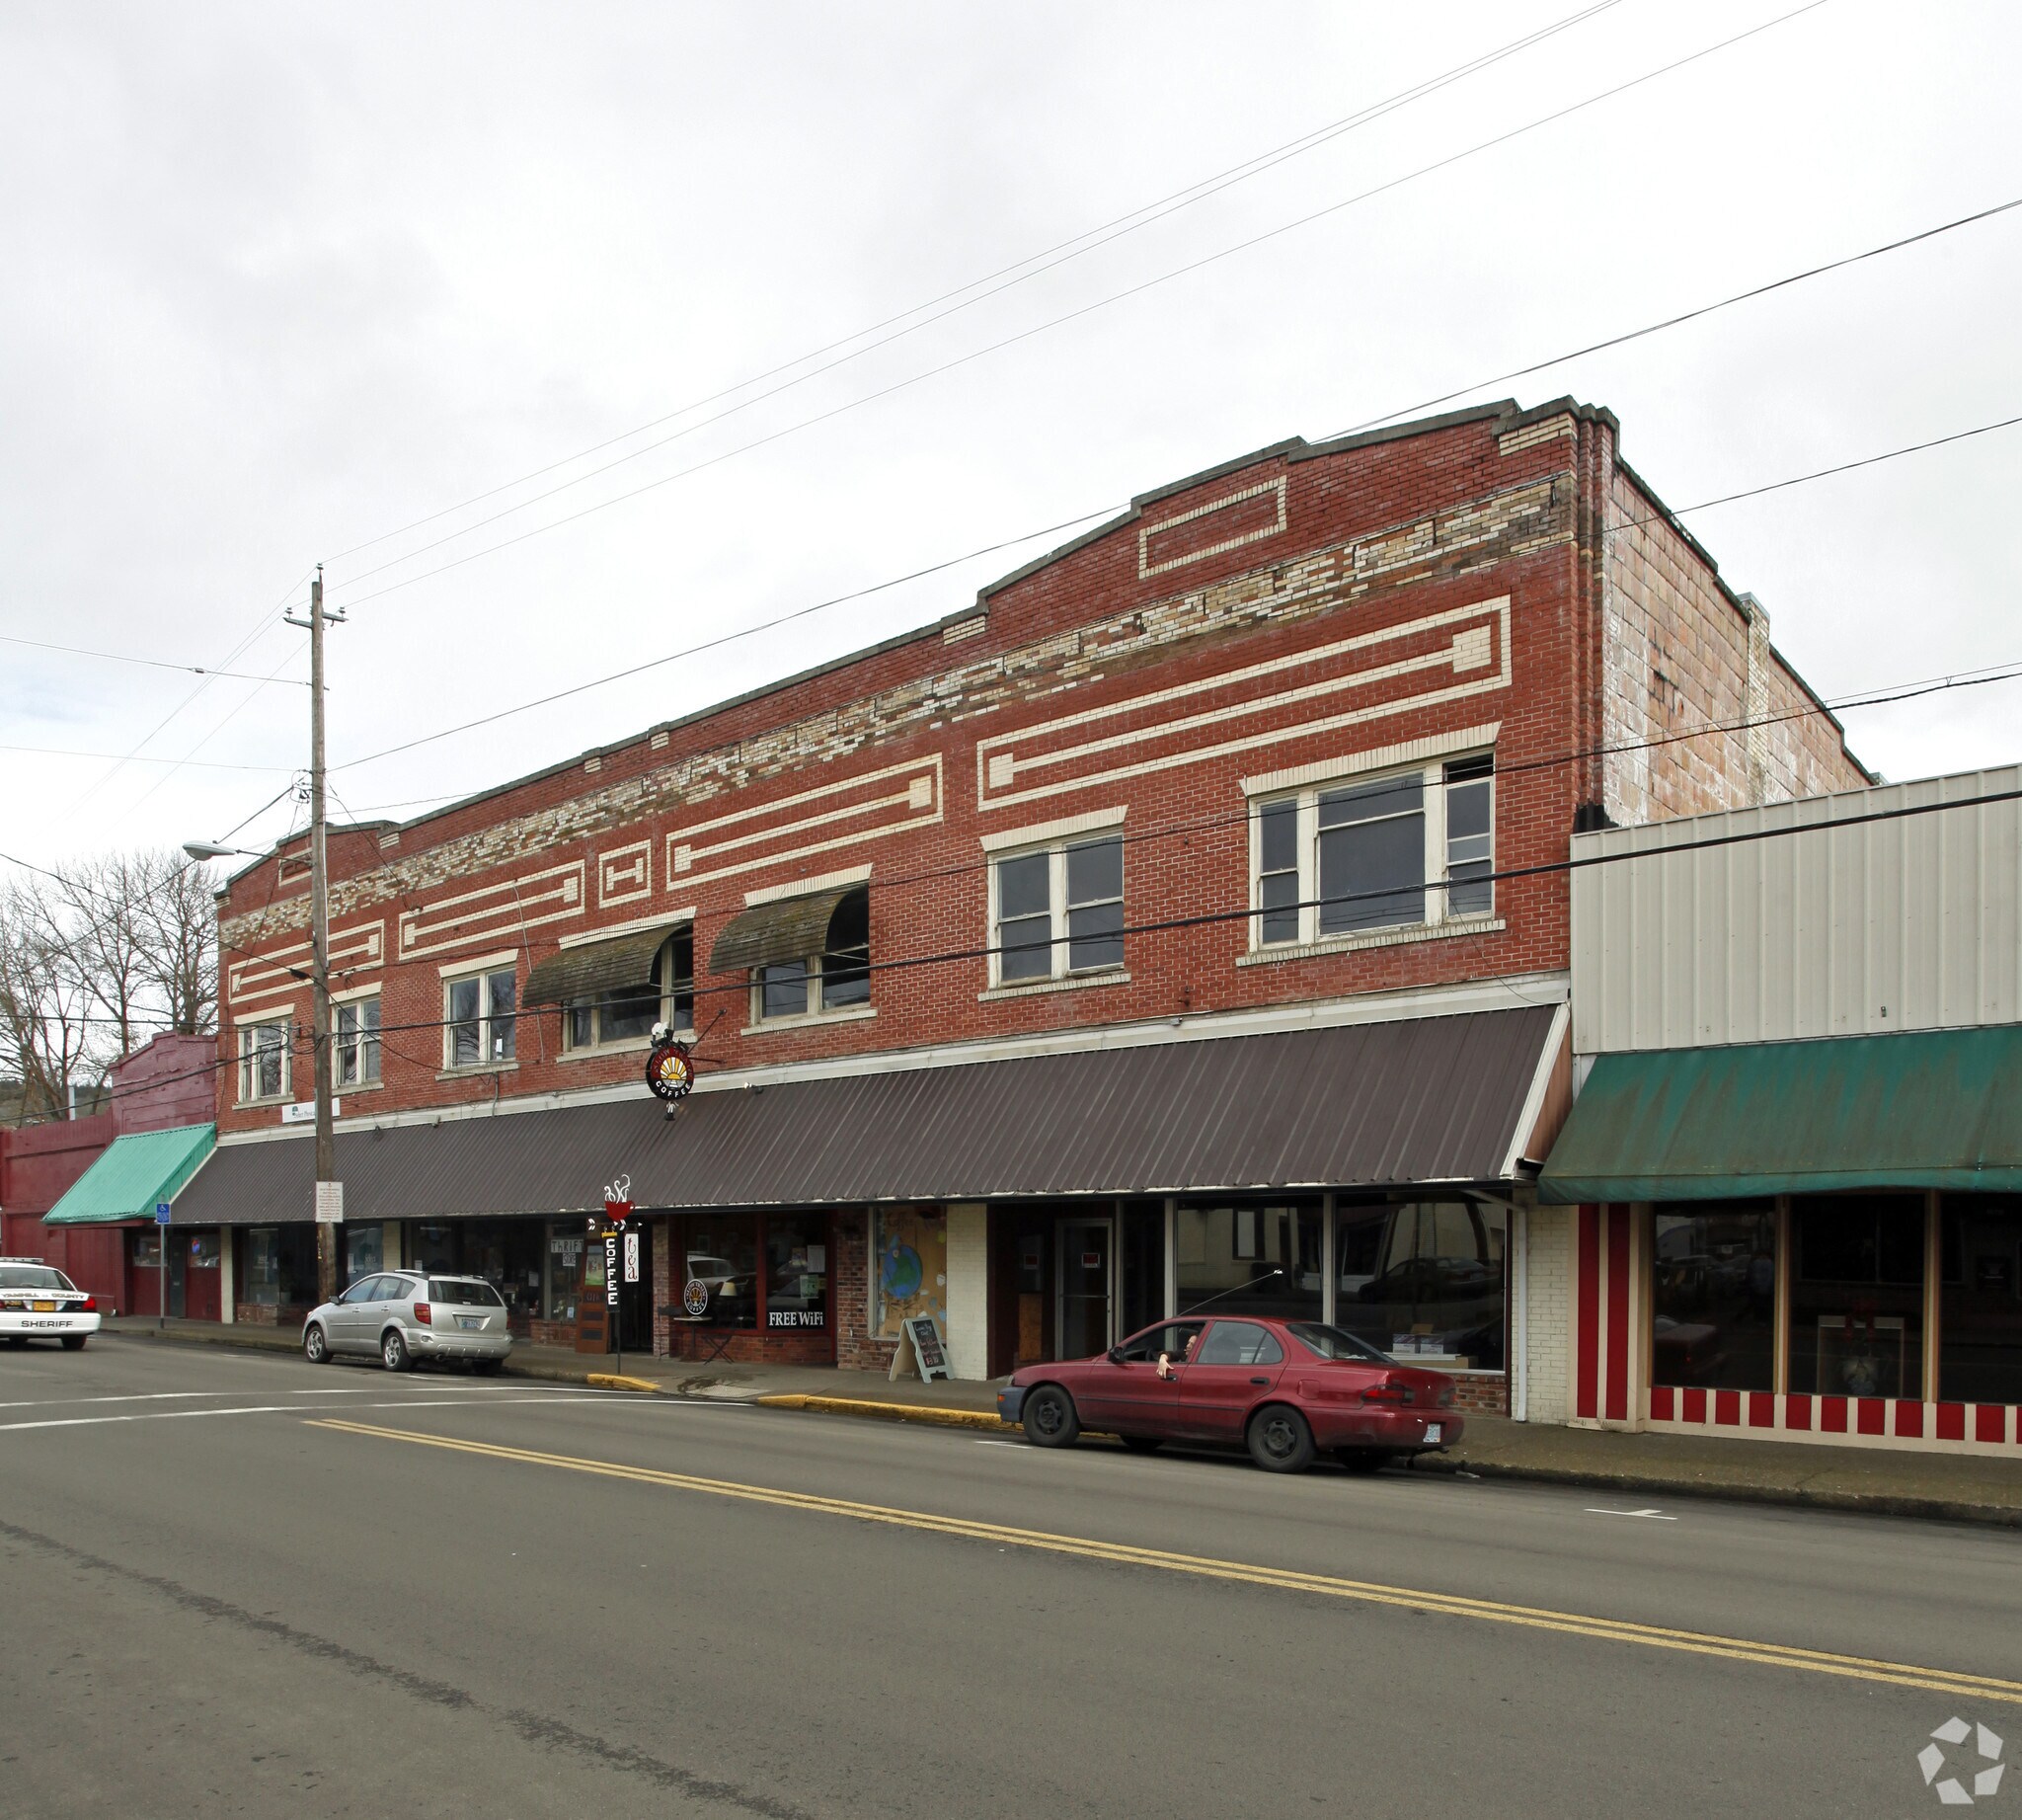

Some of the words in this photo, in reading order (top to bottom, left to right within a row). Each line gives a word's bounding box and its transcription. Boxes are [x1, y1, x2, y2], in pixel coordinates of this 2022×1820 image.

[656, 1080, 691, 1098] COFFEE
[606, 1238, 618, 1306] COFFEE
[628, 1237, 638, 1280] tea
[768, 1311, 798, 1326] FREE
[798, 1311, 824, 1326] WiFi
